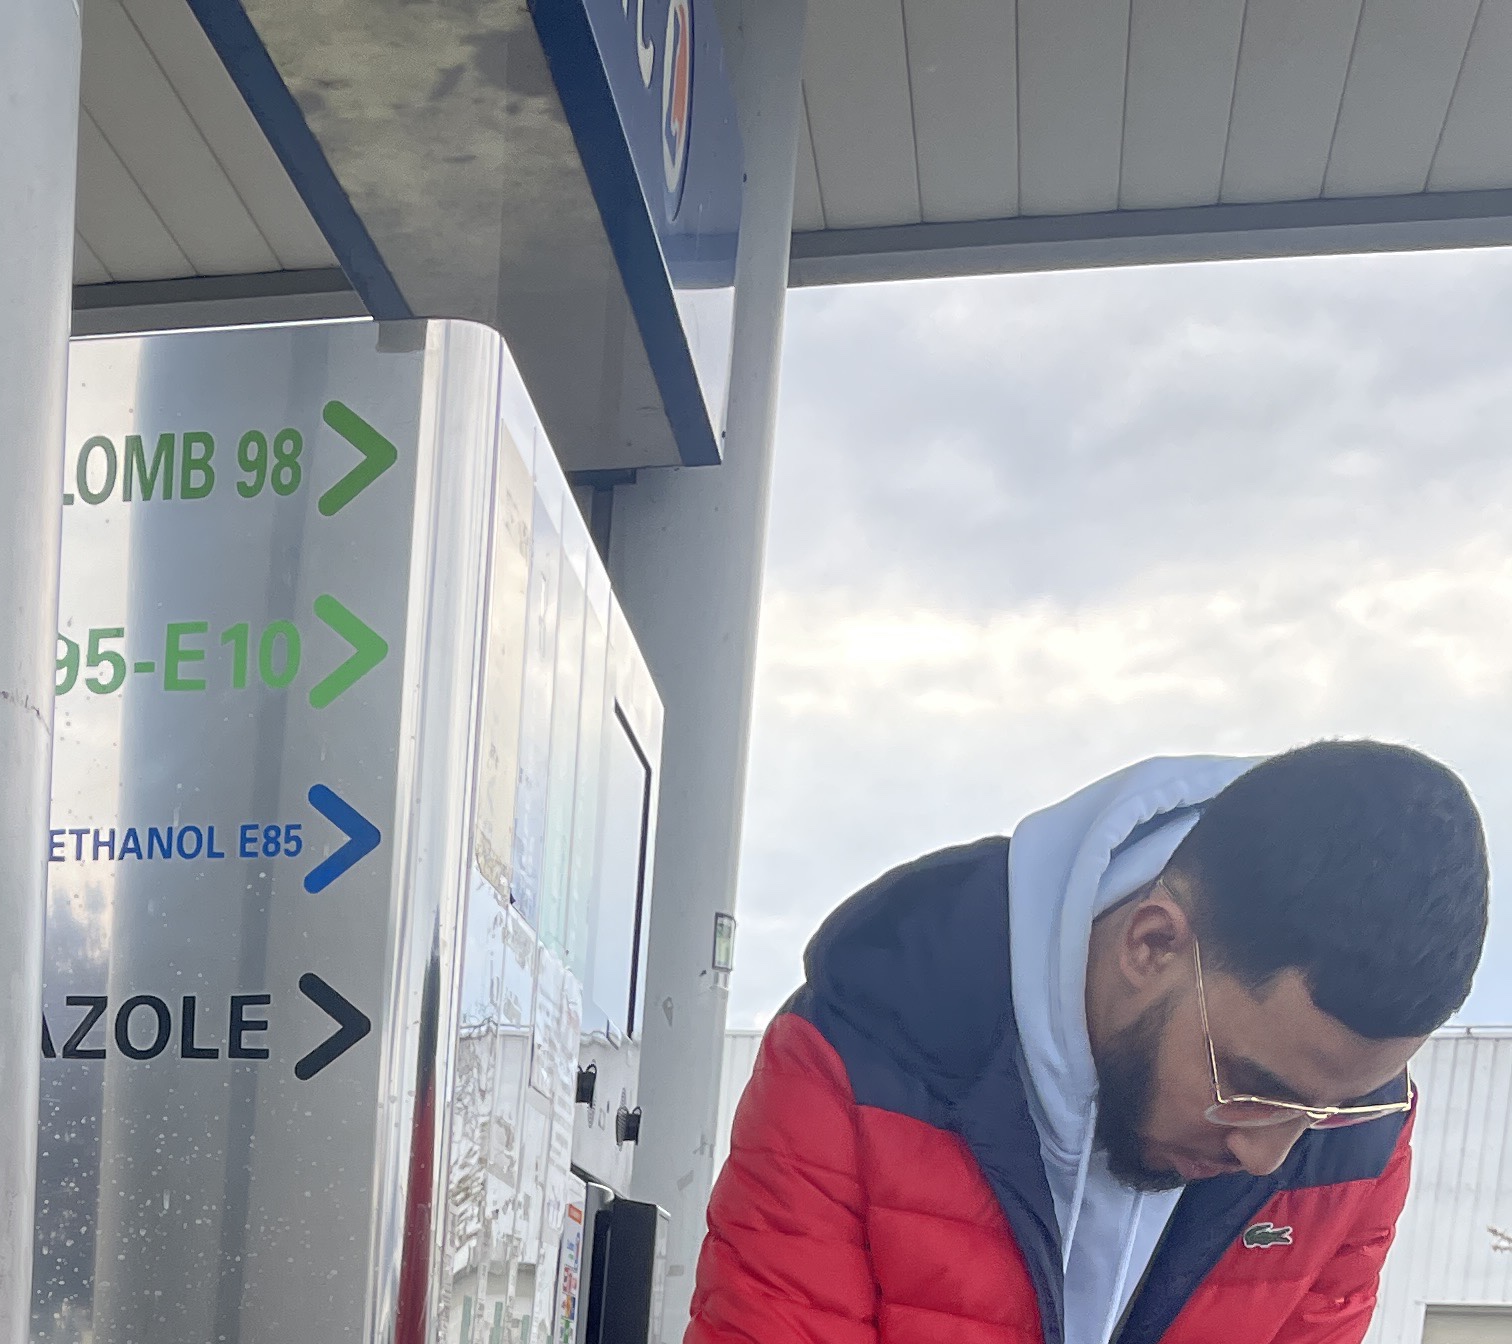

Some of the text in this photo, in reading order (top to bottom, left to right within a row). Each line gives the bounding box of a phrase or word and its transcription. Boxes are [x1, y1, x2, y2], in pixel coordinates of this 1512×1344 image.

[63, 428, 304, 505] OMB 98
[55, 619, 302, 696] 95-E10
[48, 823, 303, 862] ETHANOL E85
[41, 994, 272, 1060] ZOLE
